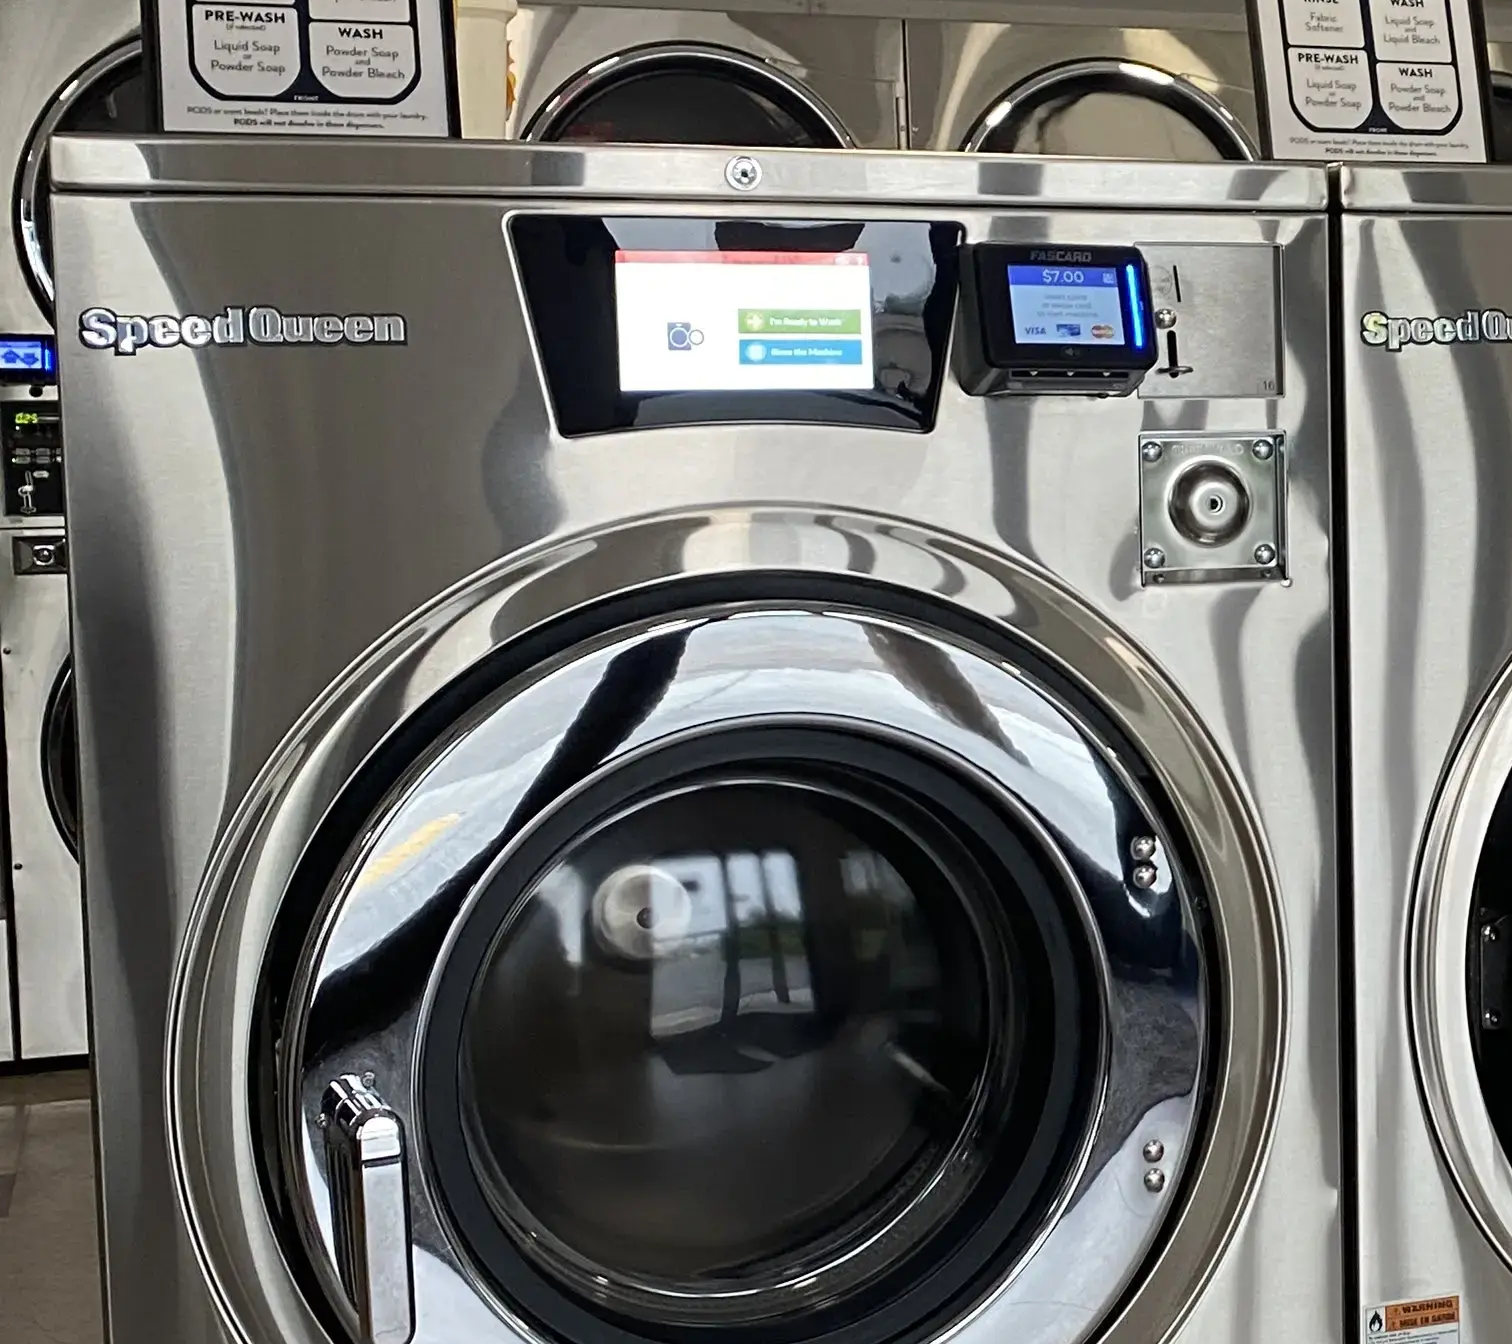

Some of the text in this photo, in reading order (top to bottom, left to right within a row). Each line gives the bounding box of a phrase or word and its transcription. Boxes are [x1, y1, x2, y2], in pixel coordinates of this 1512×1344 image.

[205, 10, 285, 23] PRE-WASH
[1310, 12, 1337, 22] Fabric
[1385, 16, 1435, 28] Liquid Soap
[338, 27, 383, 39] WASH
[1305, 22, 1343, 32] Softener
[1383, 34, 1440, 46] Liquid Bleach
[214, 40, 280, 55] Liquid Soap
[326, 45, 399, 61] Powder Soap
[1298, 53, 1358, 64] PRE-WASH
[211, 60, 285, 76] Powder Soap
[322, 66, 405, 78] Powder Bleach
[1398, 67, 1432, 78] WASH
[1306, 78, 1357, 92] Liquid Soap
[1390, 83, 1446, 96] Powder Soap
[1305, 96, 1361, 110] Powder Soap
[1388, 101, 1451, 113] Powder Bleach
[1030, 250, 1092, 262] FASCARD
[1042, 269, 1084, 283] $7.00
[79, 305, 408, 356] Speed Queen
[1025, 326, 1046, 335] VISA
[1360, 308, 1481, 352] Speed
[1263, 380, 1275, 391] 16
